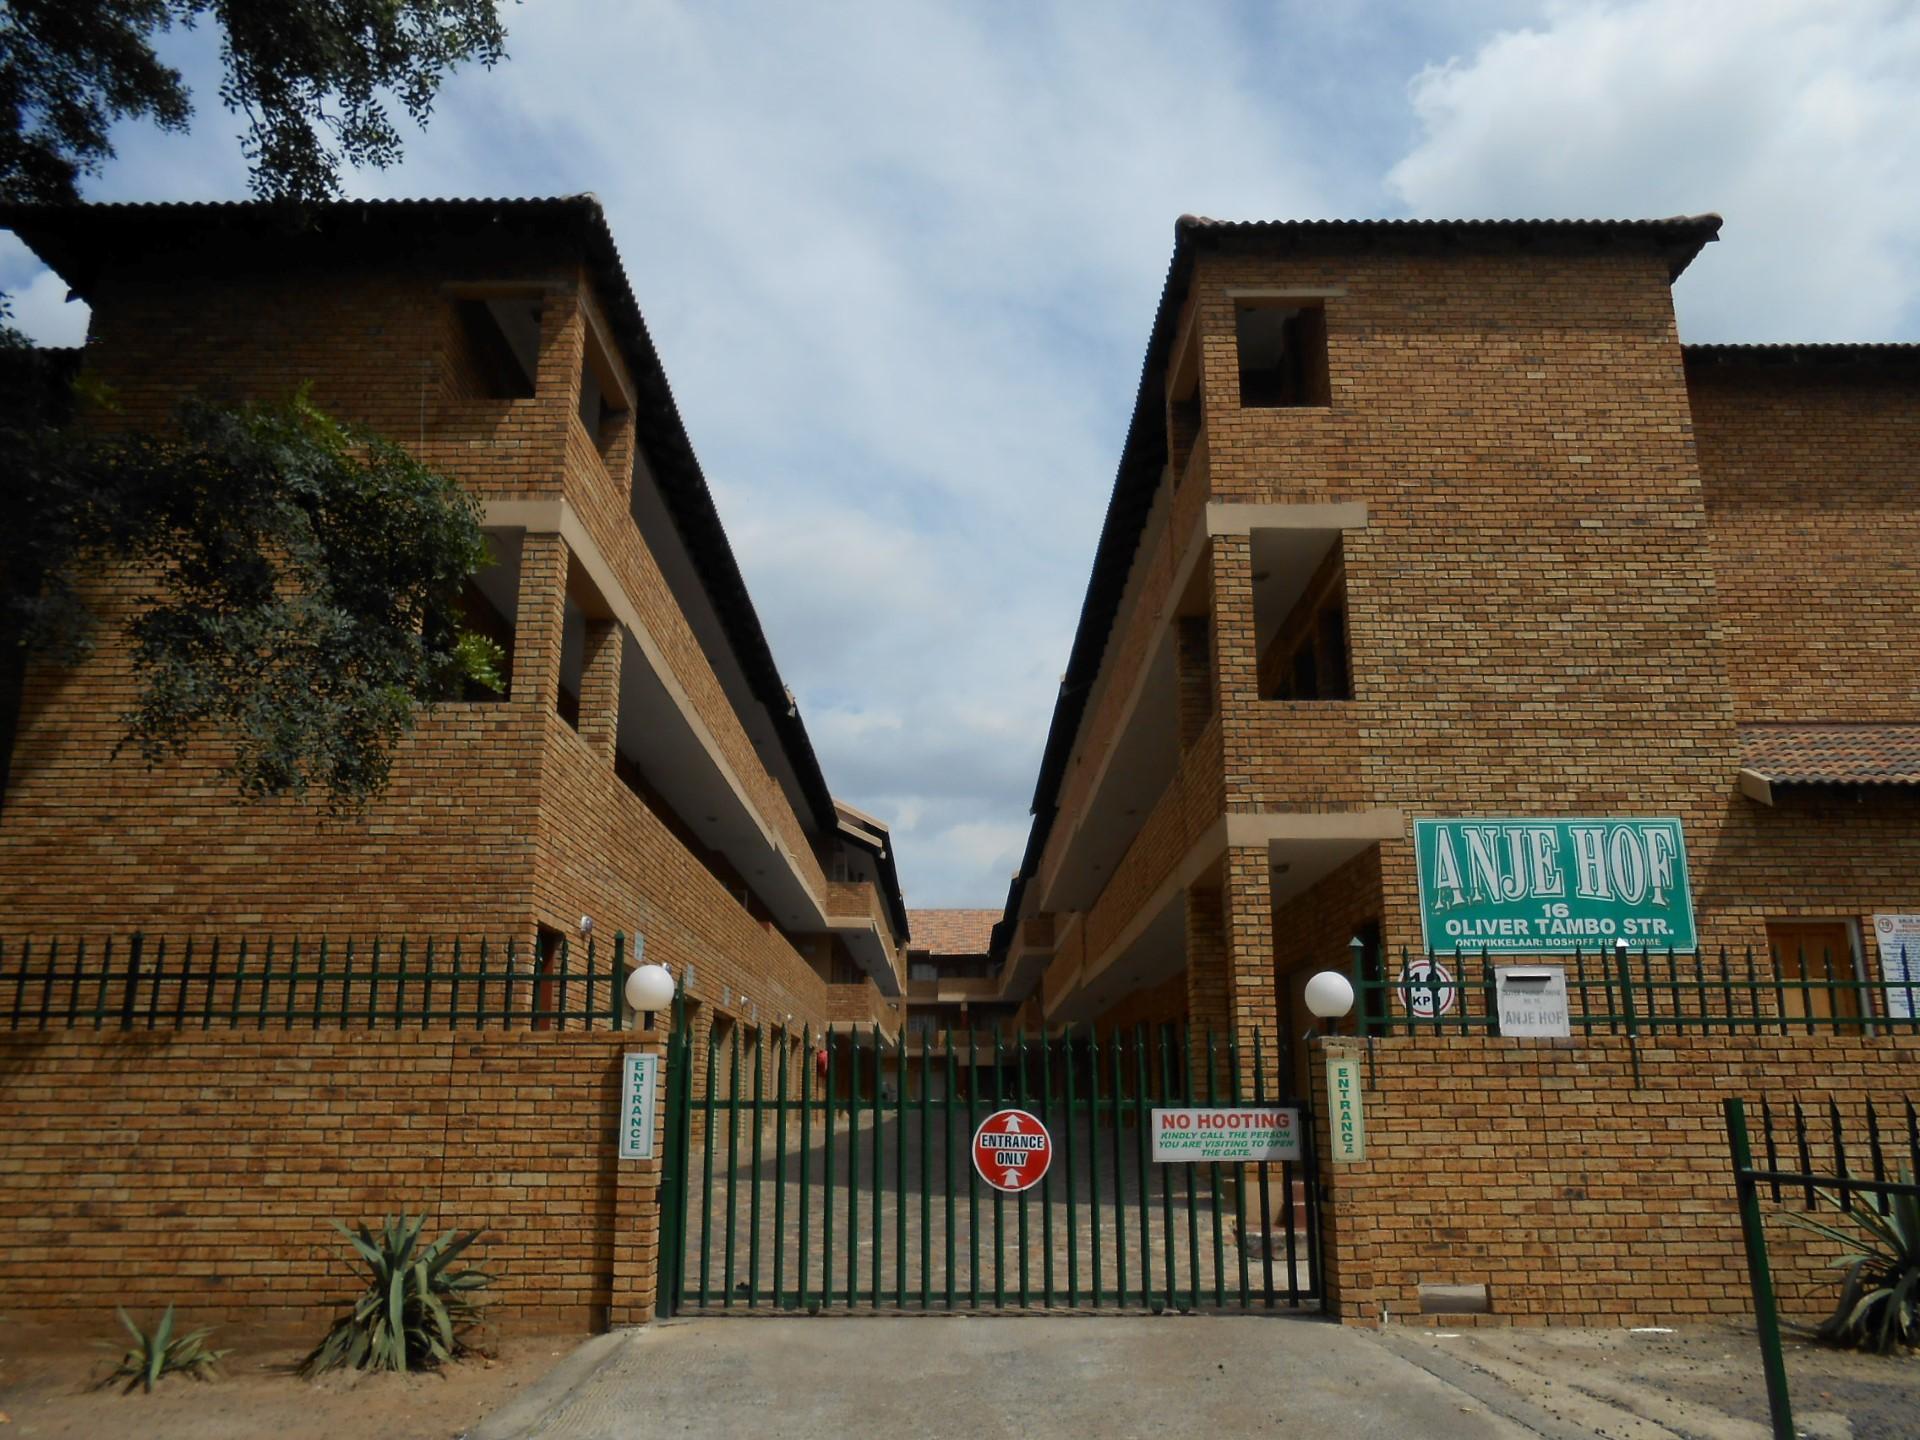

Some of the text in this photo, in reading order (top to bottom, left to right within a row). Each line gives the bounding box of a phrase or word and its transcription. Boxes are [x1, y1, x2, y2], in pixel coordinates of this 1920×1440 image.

[1432, 824, 1677, 909] ANJE HOF
[1542, 903, 1569, 918] 16
[1445, 918, 1675, 936] OLIVER TAMBO STR.
[1455, 937, 1662, 947] ONTWIKKELAAR: BOSHOFF EIEOMME
[1412, 996, 1441, 1006] KP
[1505, 1011, 1562, 1025] ANJE HOF
[630, 1062, 644, 1149] ENTRANCE
[1338, 1068, 1354, 1153] ENTRANCE
[1161, 1113, 1290, 1129] NO HOOTING
[981, 1135, 1044, 1148] ENTRANCE
[1204, 1140, 1248, 1148] VISITING
[997, 1152, 1027, 1165] ONLY
